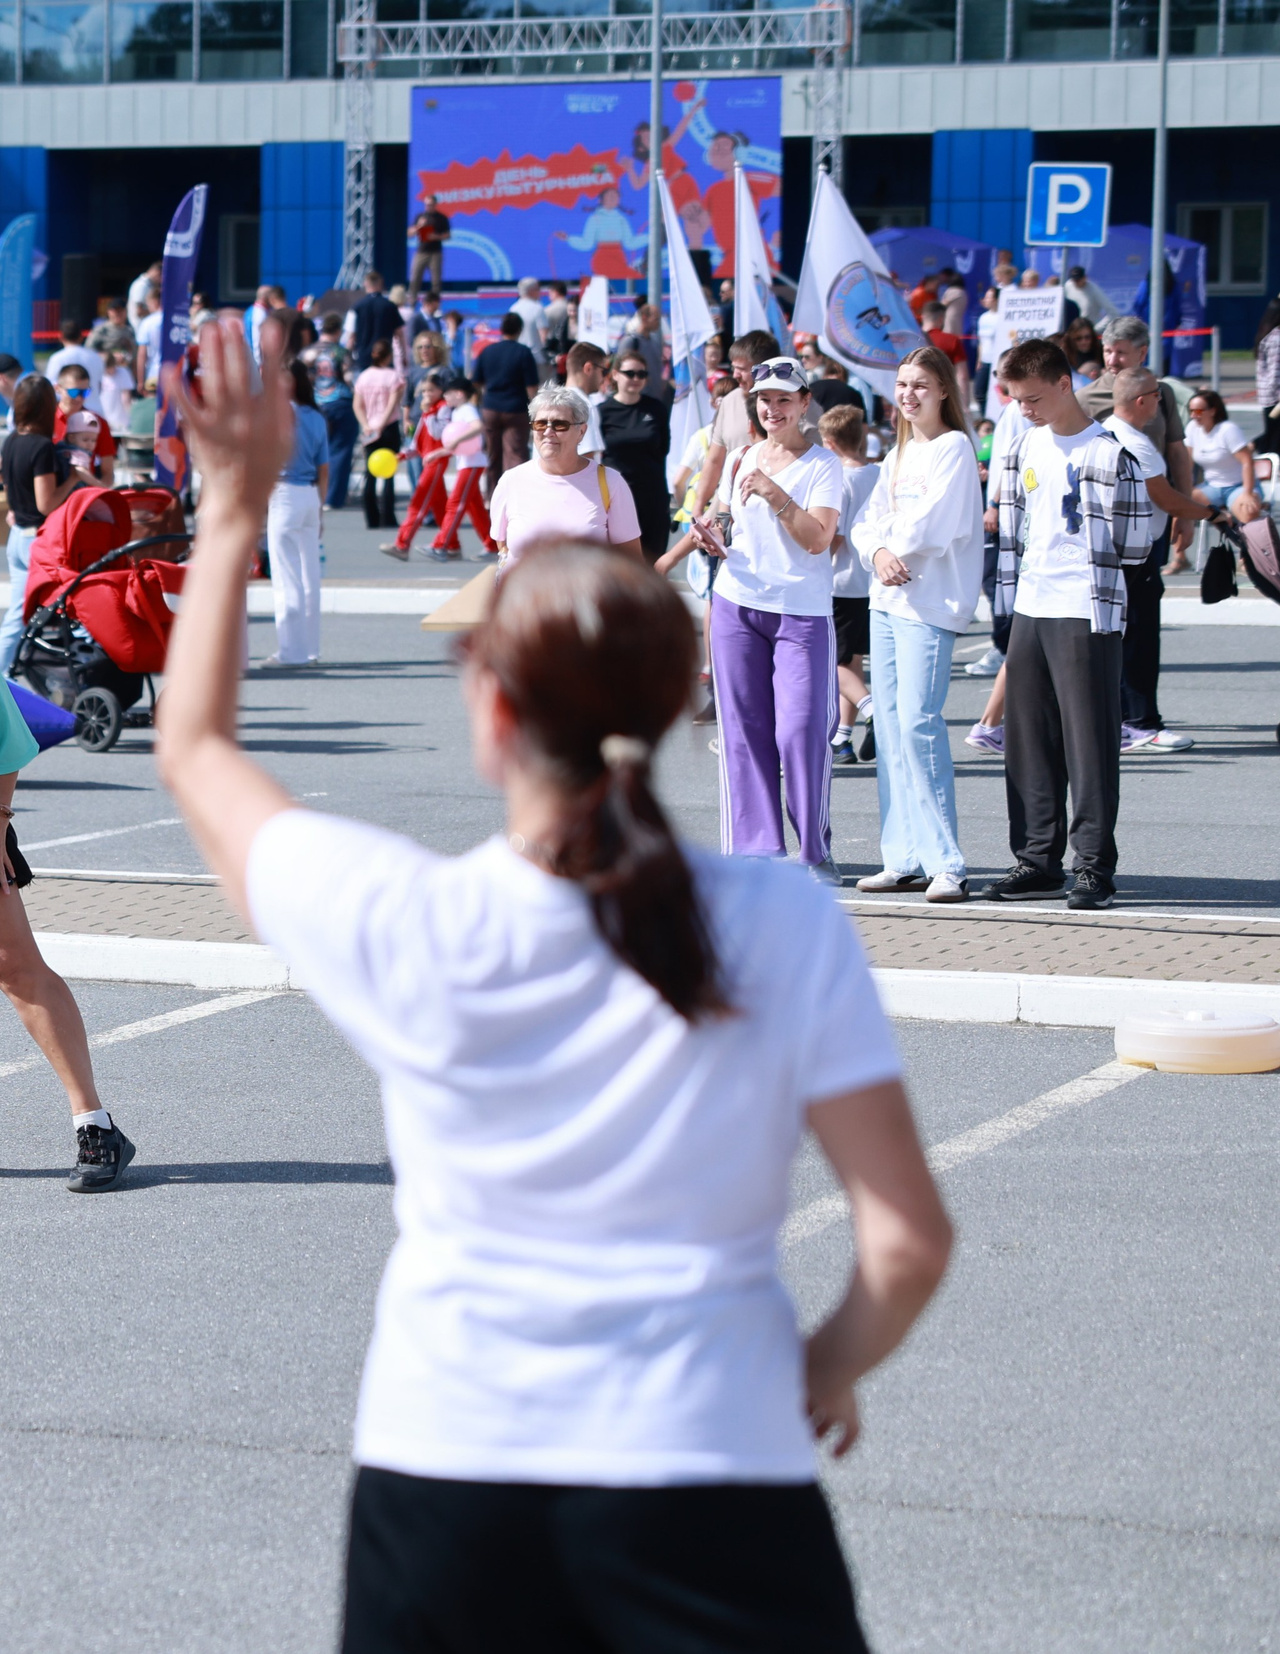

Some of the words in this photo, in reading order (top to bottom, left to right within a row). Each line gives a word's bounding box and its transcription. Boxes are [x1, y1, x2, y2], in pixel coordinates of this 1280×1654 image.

[493, 165, 549, 186] ДЕНЬ
[1045, 173, 1092, 236] P
[1004, 308, 1055, 321] ИГРОТЕКА
